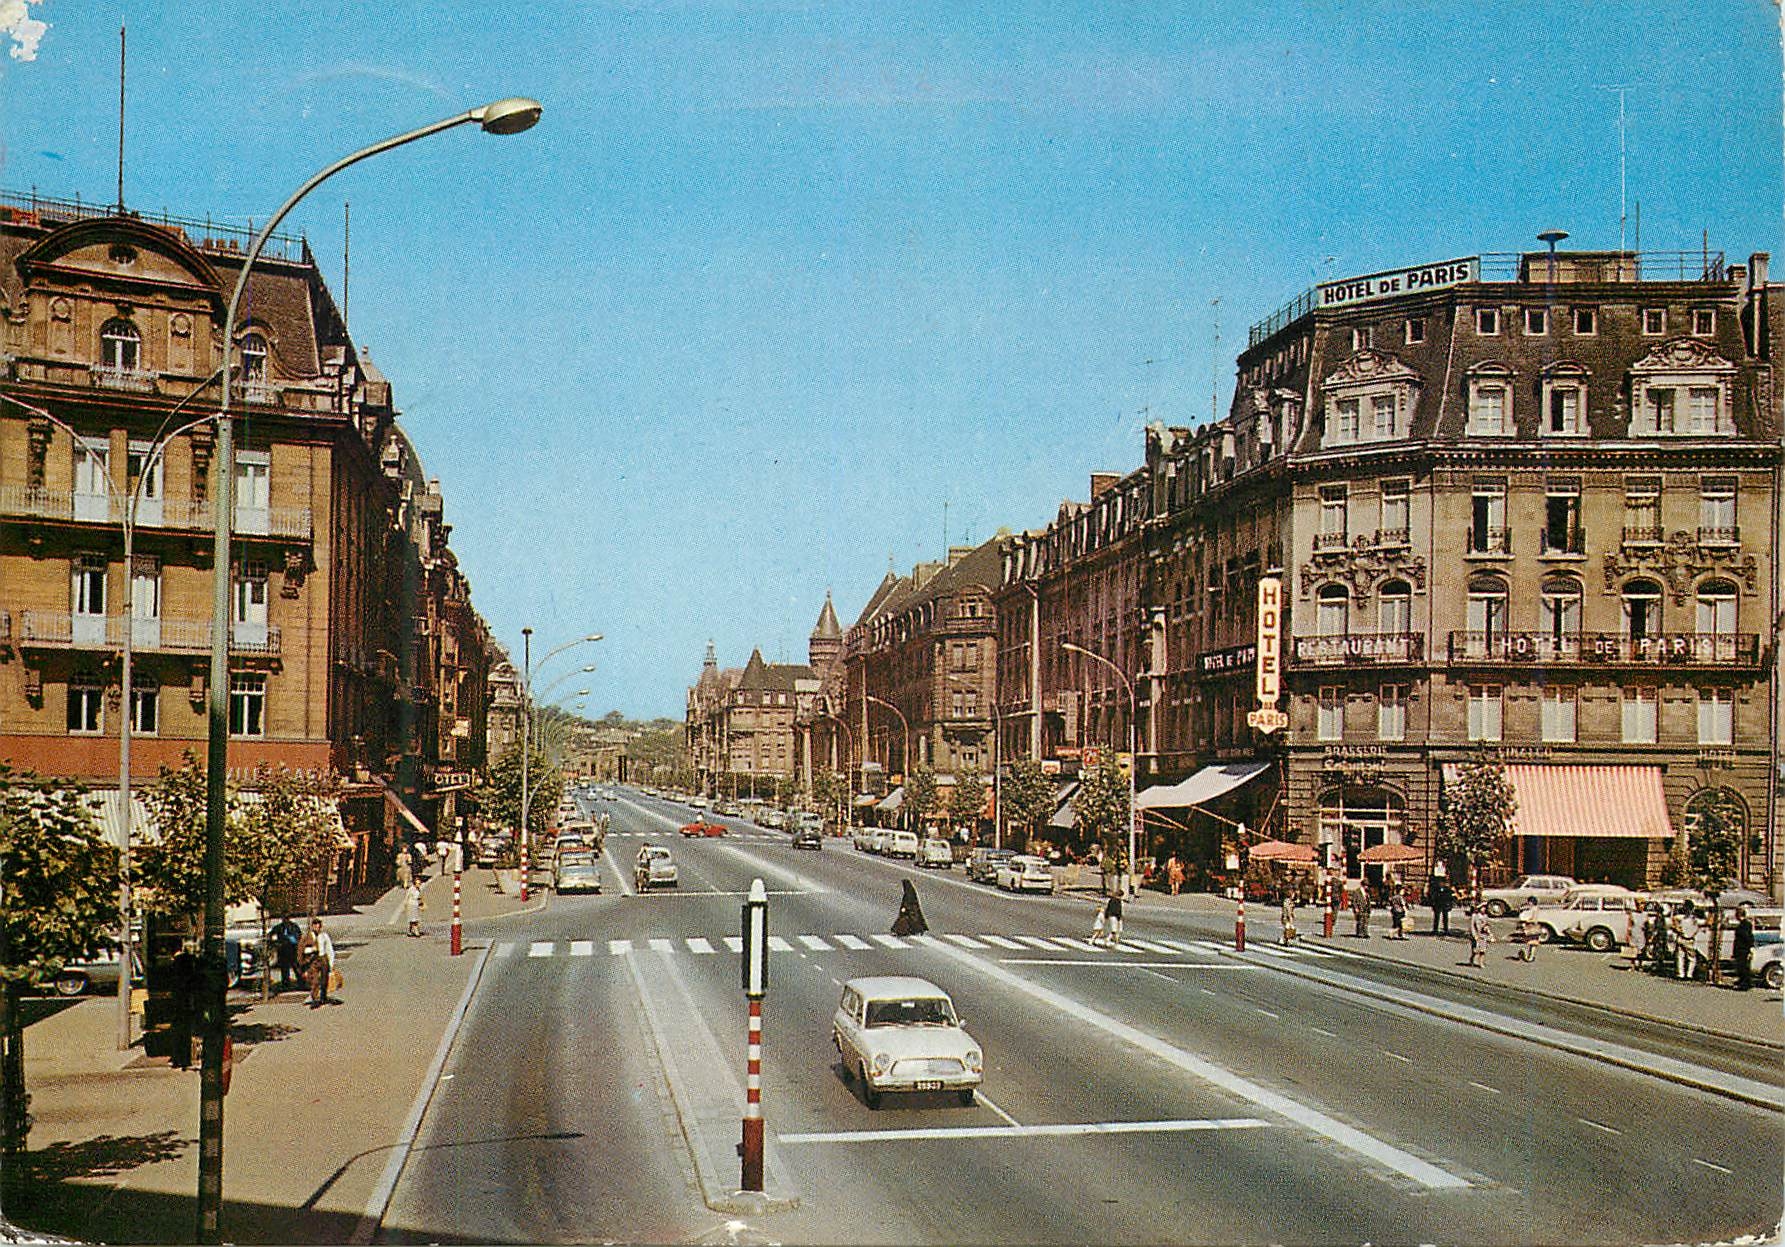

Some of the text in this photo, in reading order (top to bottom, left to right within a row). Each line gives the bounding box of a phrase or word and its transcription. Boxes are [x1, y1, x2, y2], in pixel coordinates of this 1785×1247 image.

[1324, 264, 1469, 304] HOTEL DE PARIS
[1262, 587, 1277, 695] HOTEL
[1297, 638, 1410, 658] RESTAURANT
[1502, 637, 1713, 655] HOTEL DE PARIS
[1249, 713, 1287, 726] PARIS
[1324, 745, 1389, 756] BRASSERIE
